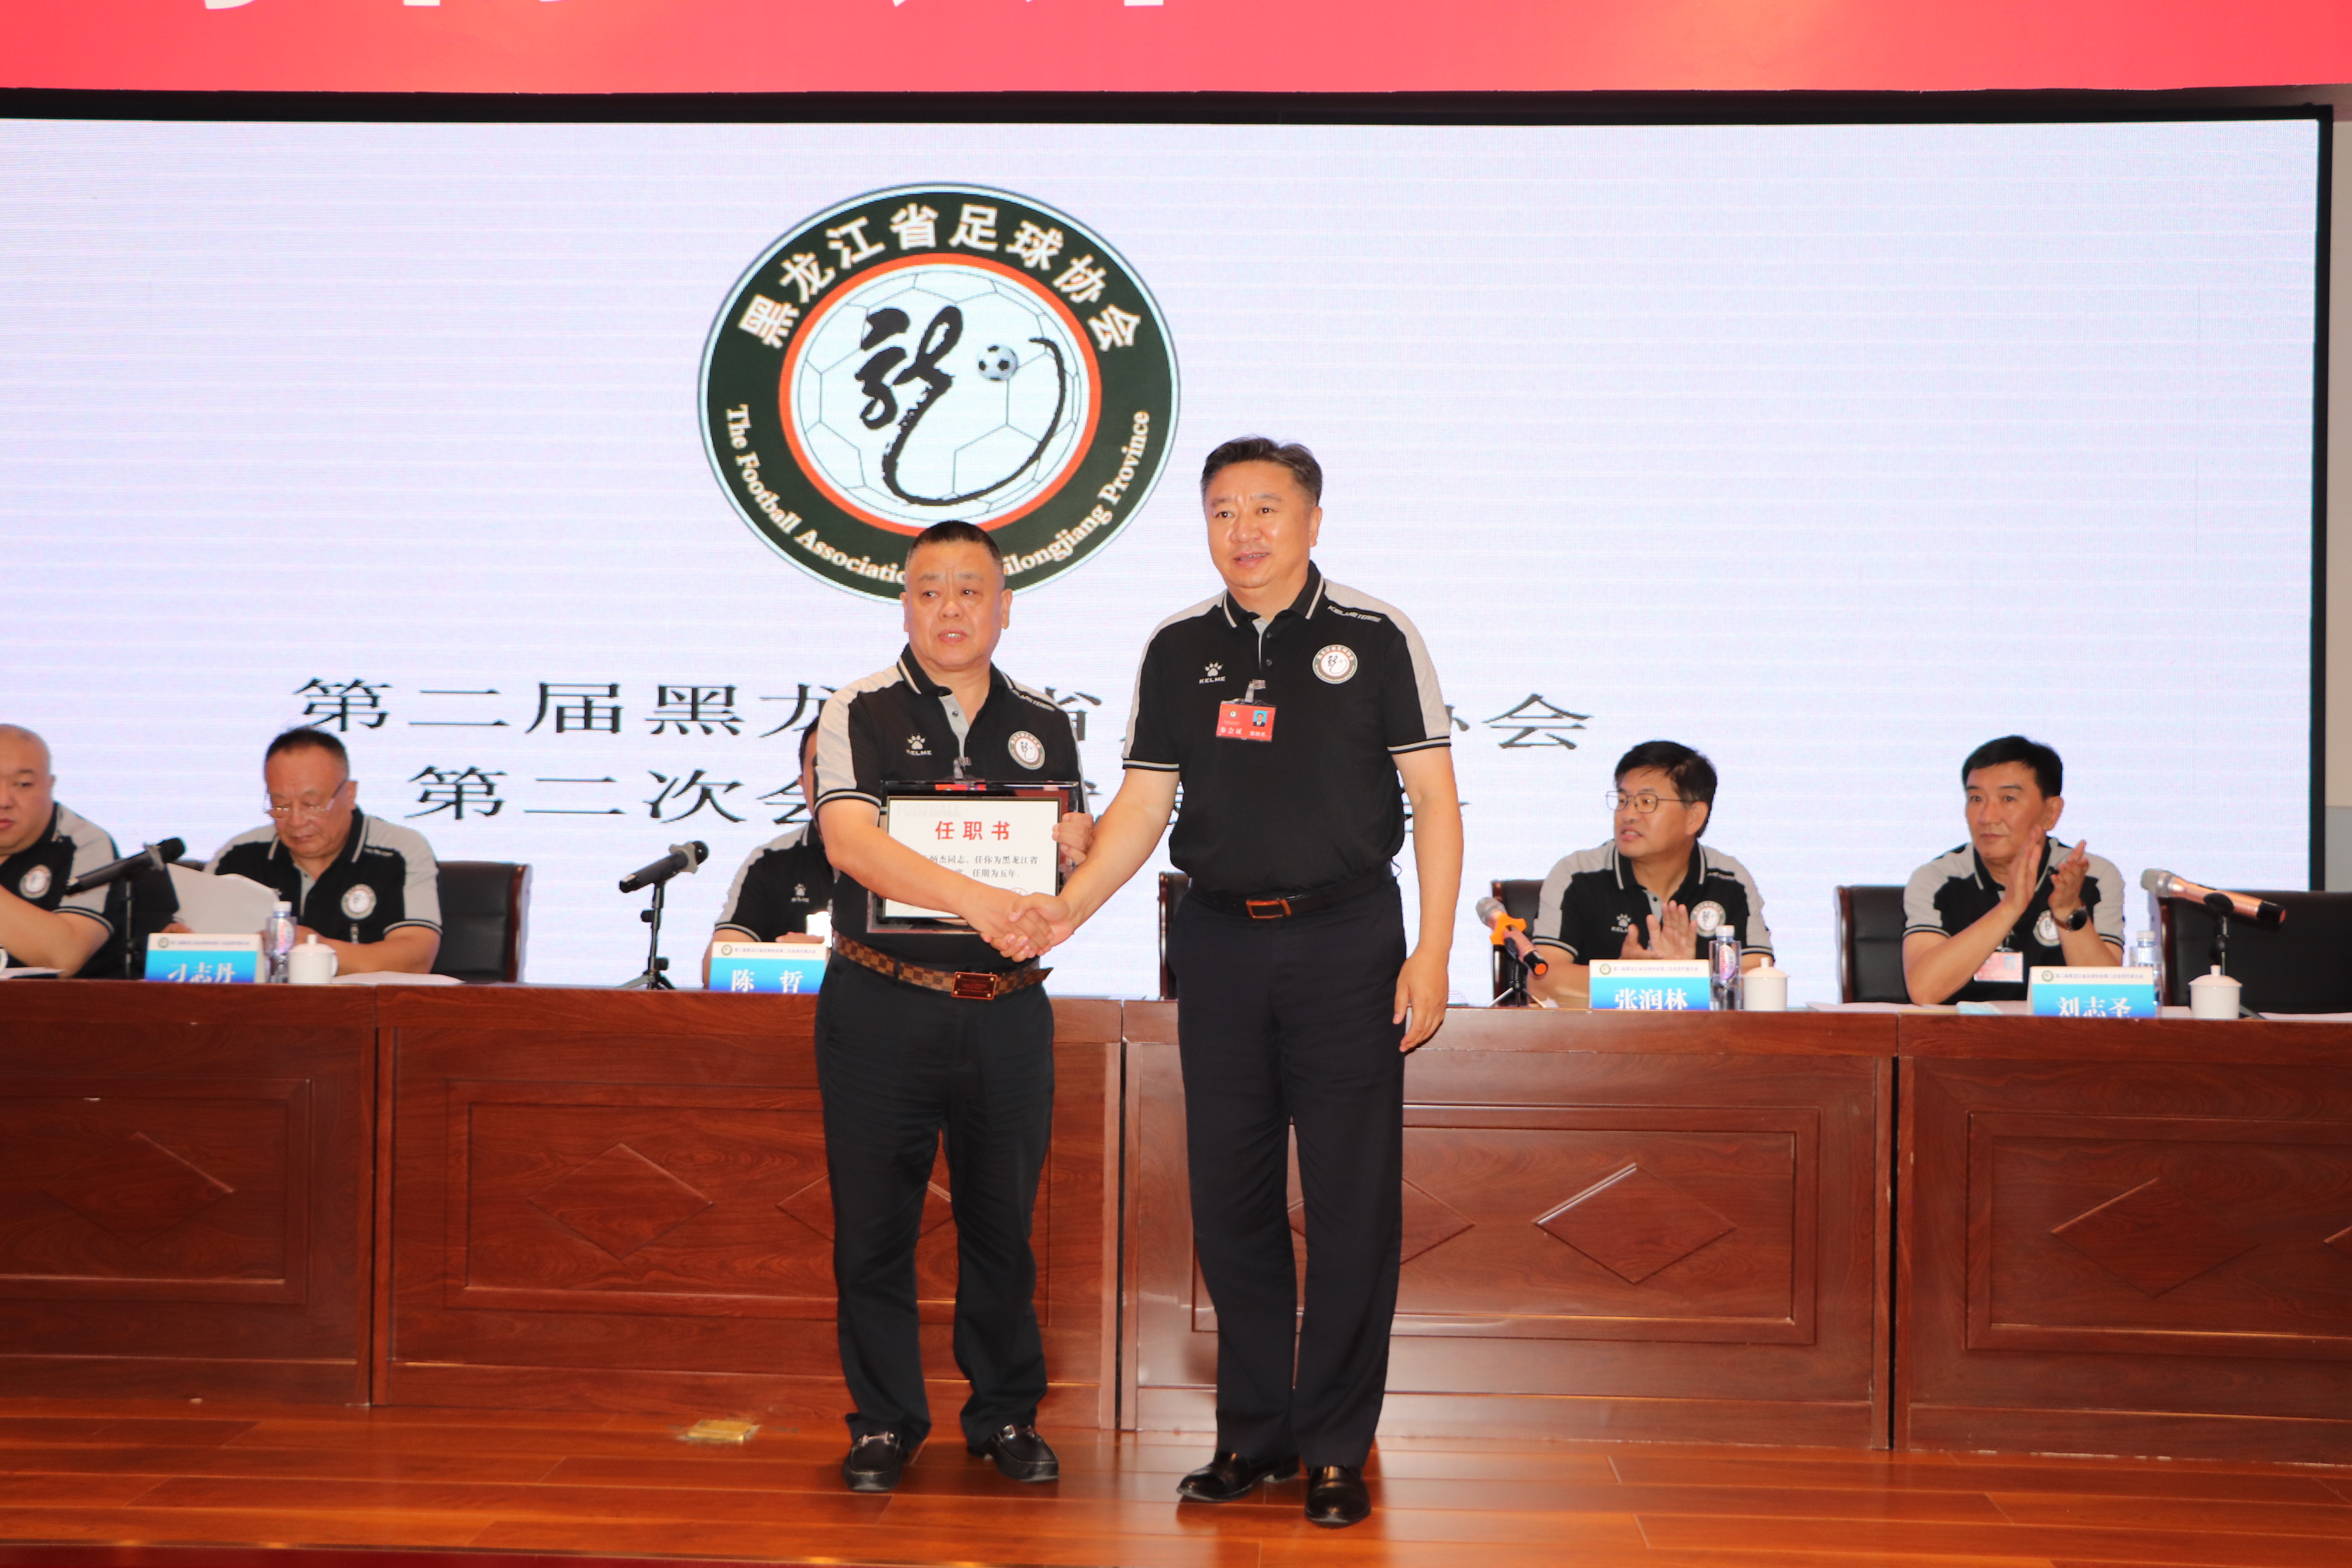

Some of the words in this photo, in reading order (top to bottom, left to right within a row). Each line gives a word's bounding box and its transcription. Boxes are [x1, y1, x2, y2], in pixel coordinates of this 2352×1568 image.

[739, 204, 1142, 351] 黑龙江省足球协会
[726, 404, 751, 449] The
[1099, 411, 1149, 506] Province
[736, 452, 803, 535] Football
[795, 529, 906, 584] Associatio
[1198, 676, 1226, 684] KELME
[935, 821, 1011, 841] 任职书
[167, 962, 236, 984] 刁志丹
[731, 969, 803, 993] 陈哲
[1614, 988, 1688, 1010] 张润林
